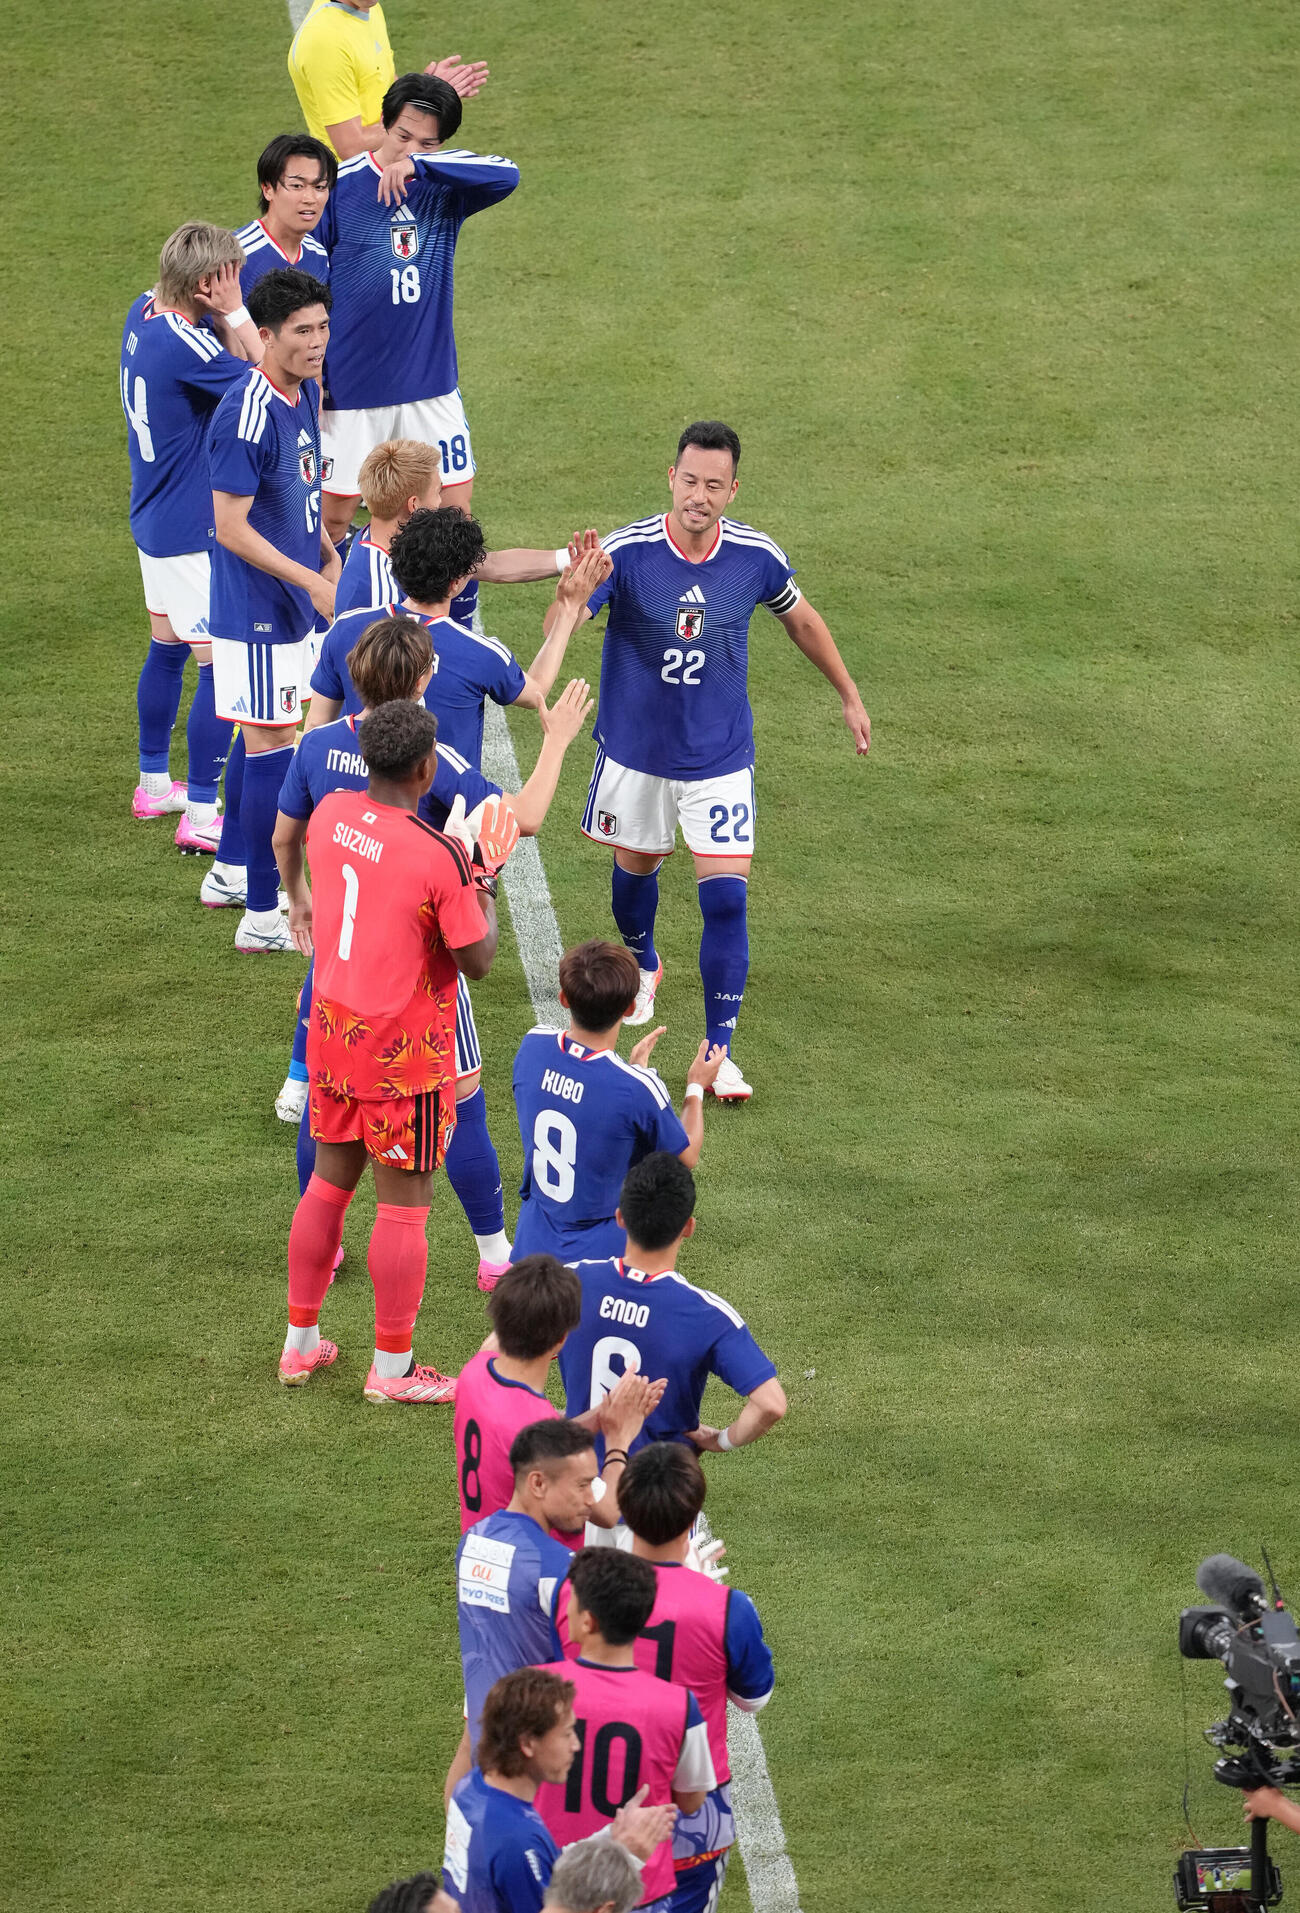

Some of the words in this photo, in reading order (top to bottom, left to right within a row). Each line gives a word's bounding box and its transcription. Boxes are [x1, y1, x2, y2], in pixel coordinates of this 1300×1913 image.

[390, 264, 421, 305] 18
[125, 330, 139, 357] ITO
[438, 434, 468, 474] 18
[660, 648, 706, 685] 22
[326, 748, 369, 778] ITAKU
[332, 821, 384, 864] SUZUKI
[709, 803, 750, 843] 22
[338, 863, 360, 961] 1
[714, 992, 744, 1002] JAPA
[541, 1068, 585, 1104] KUBO
[532, 1109, 578, 1204] 8
[599, 1295, 650, 1328] ENDO
[462, 1417, 482, 1513] 8
[564, 1717, 643, 1819] 10
